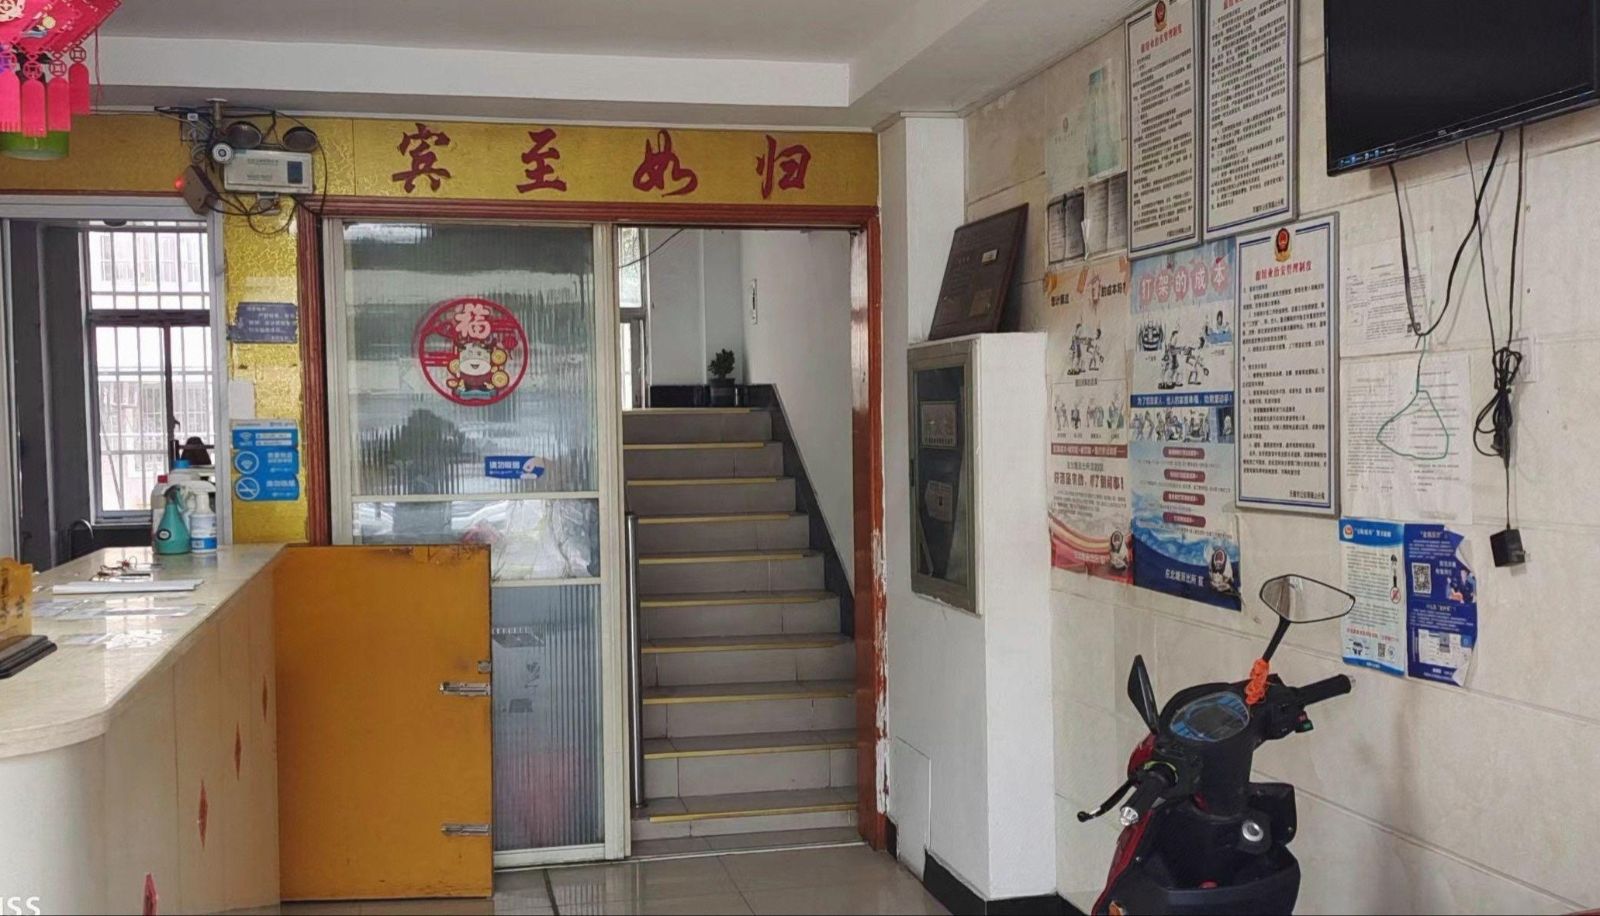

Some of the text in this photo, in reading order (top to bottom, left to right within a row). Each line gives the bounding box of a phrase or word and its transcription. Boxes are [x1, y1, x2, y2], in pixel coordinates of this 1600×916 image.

[392, 123, 811, 199] 宾至如归
[1142, 264, 1227, 300] 打架的成本
[455, 303, 491, 339] 福
